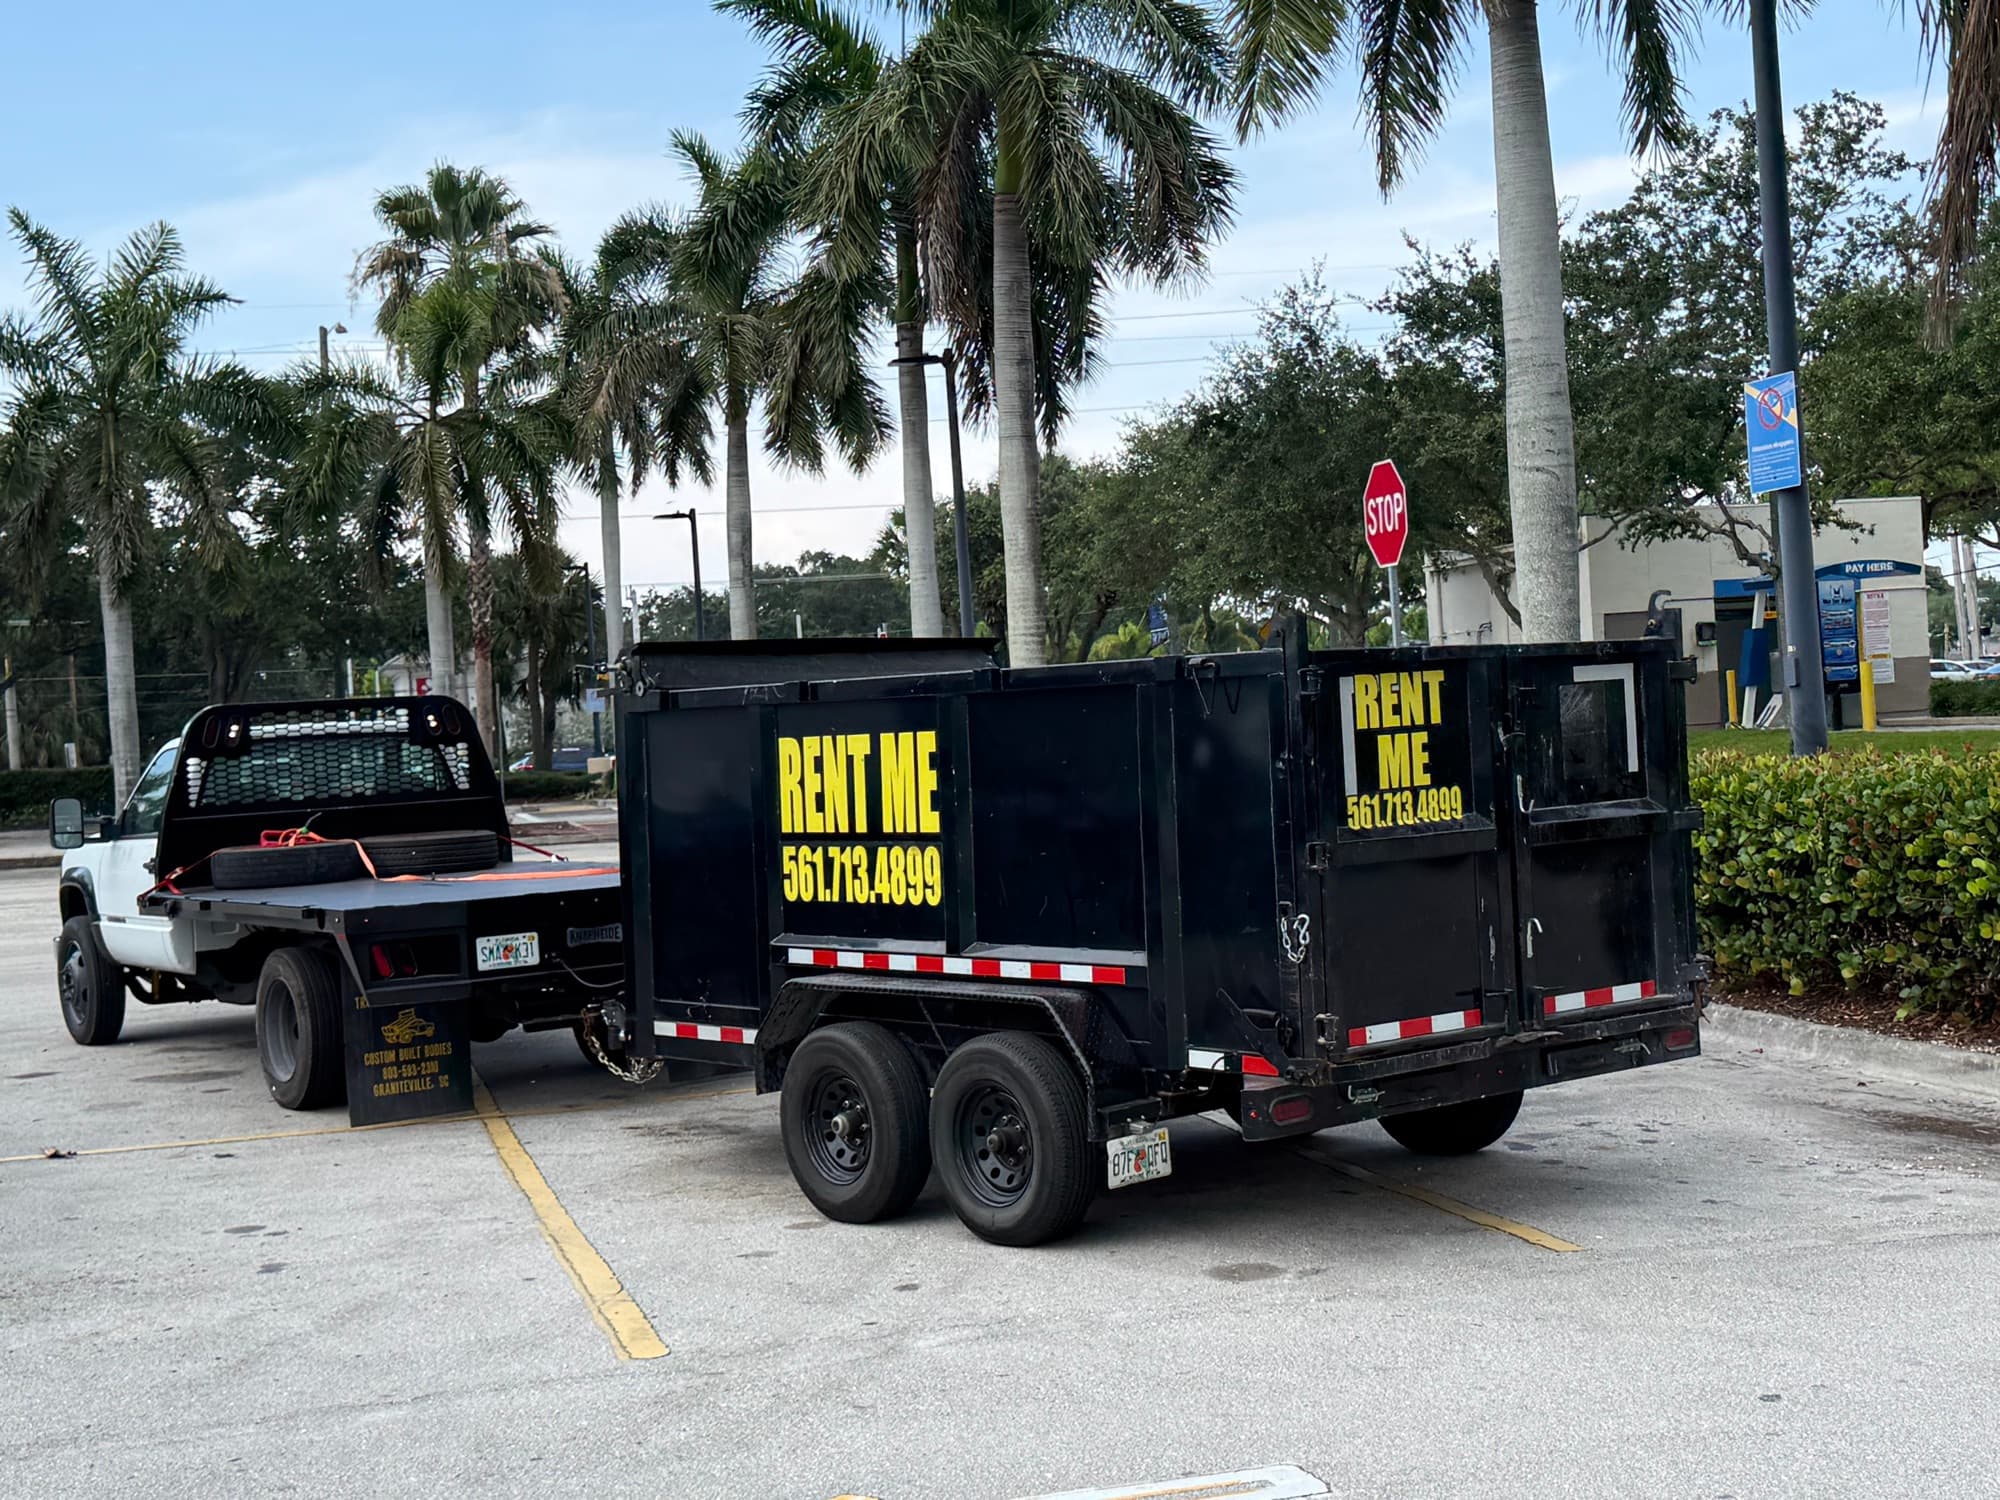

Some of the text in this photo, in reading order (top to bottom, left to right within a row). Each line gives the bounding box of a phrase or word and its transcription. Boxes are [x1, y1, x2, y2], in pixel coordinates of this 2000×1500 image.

[1368, 492, 1403, 536] STOP
[1845, 562, 1894, 573] PAY HERE
[1354, 670, 1445, 730] RENT
[778, 731, 941, 833] RENT ME
[1377, 731, 1432, 790] ME
[1347, 785, 1463, 830] 561.713.4899
[782, 845, 942, 906] 561.713.4899
[364, 1041, 452, 1066] CUSTOM BUILT BODIES
